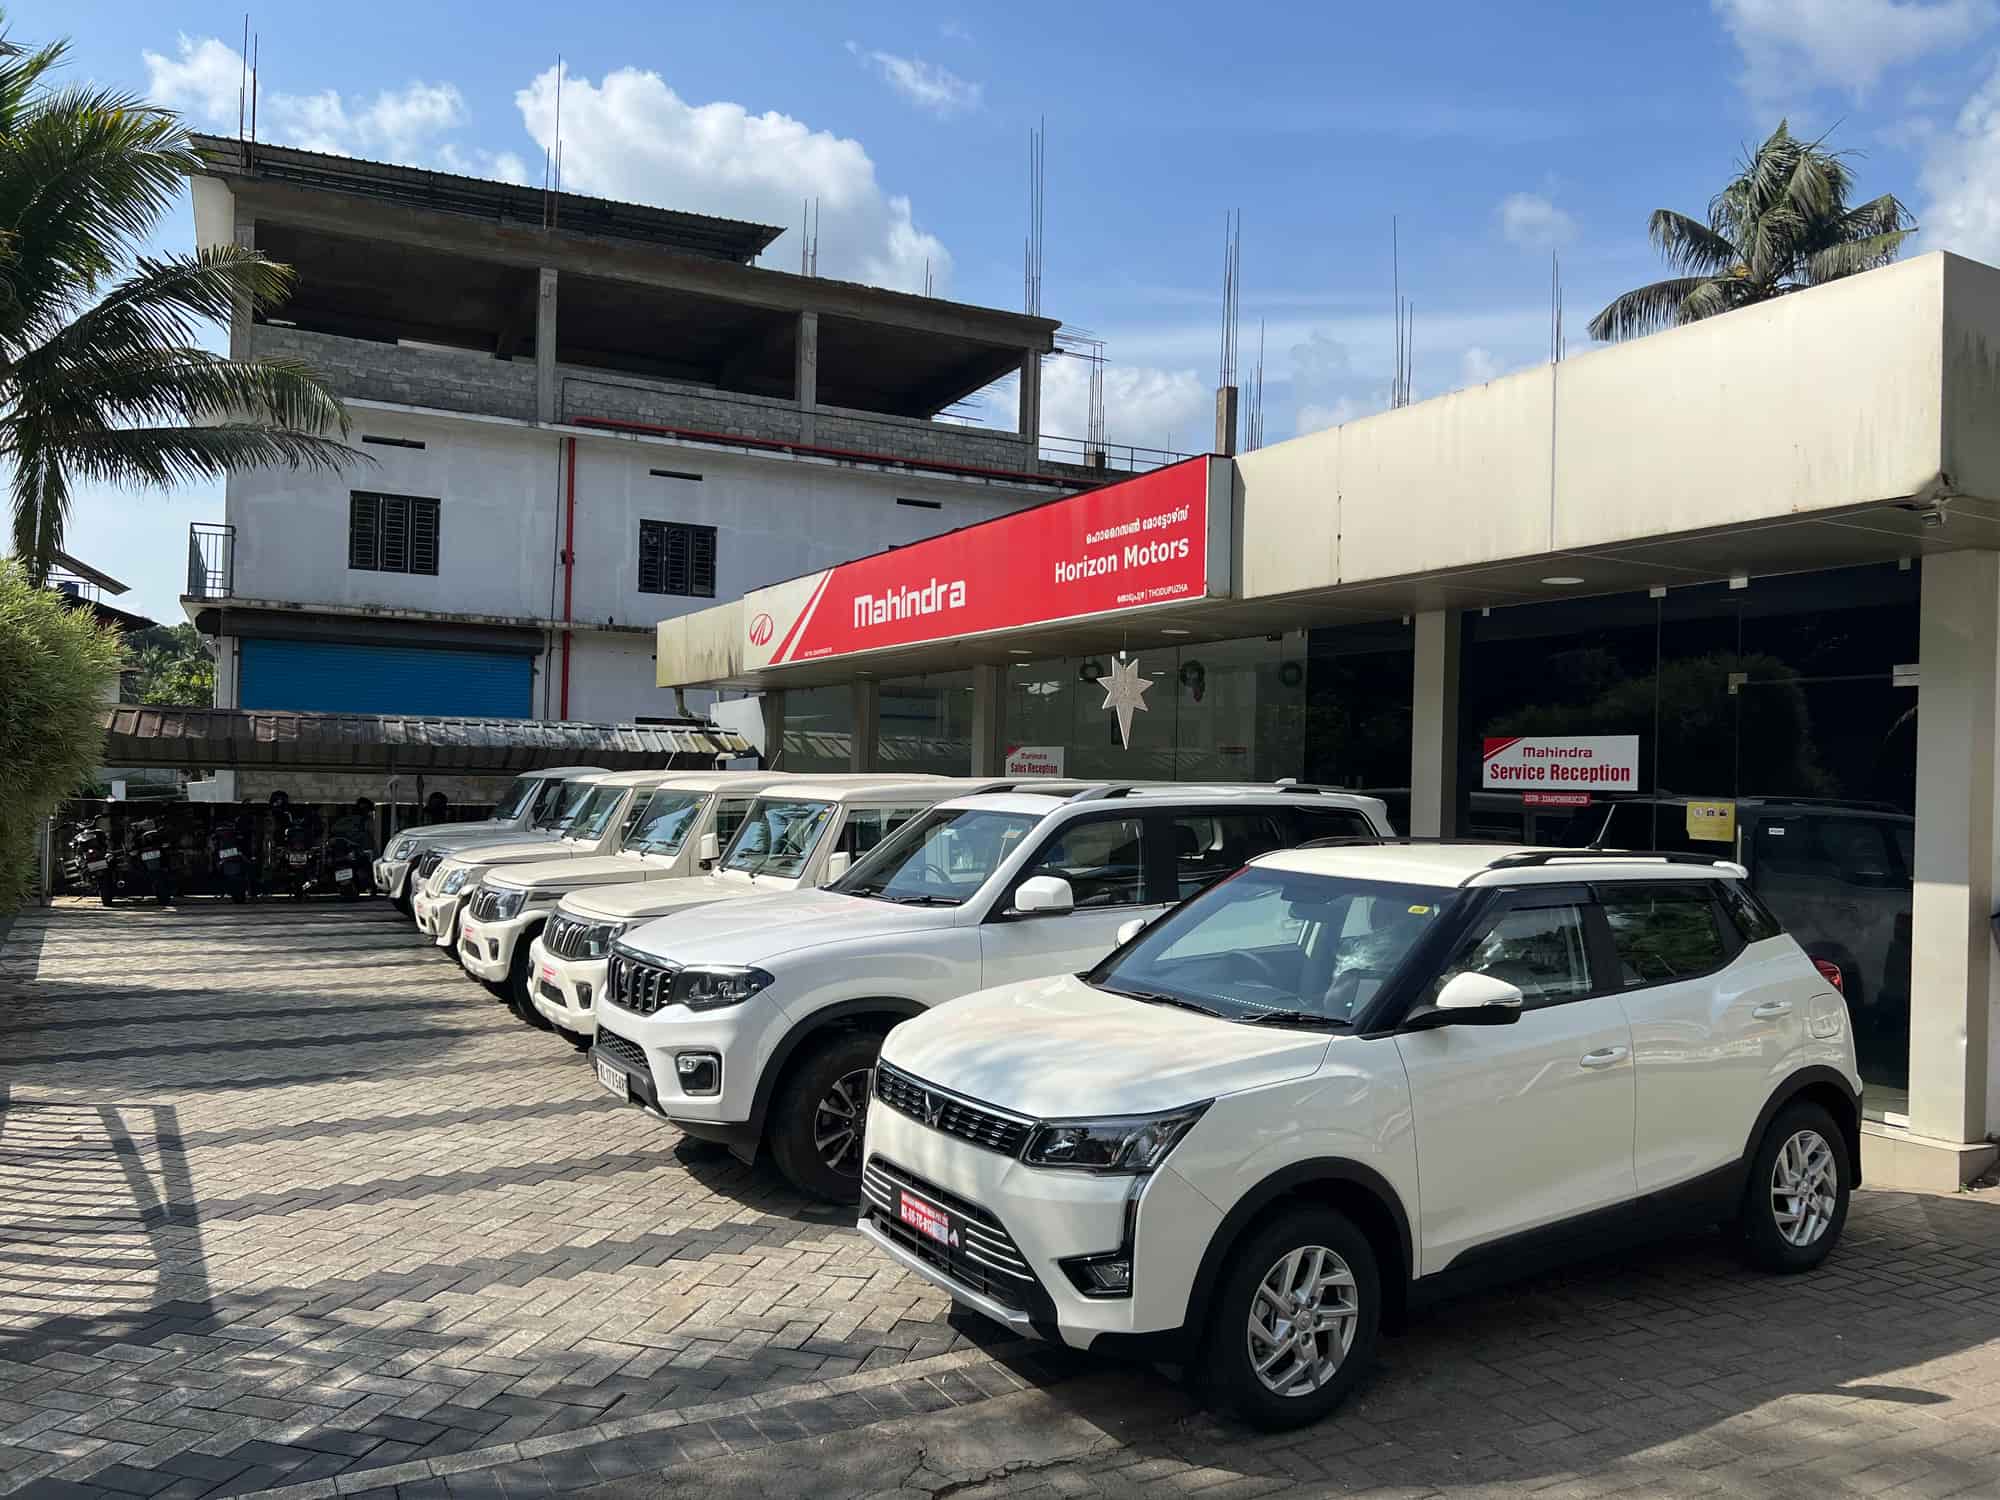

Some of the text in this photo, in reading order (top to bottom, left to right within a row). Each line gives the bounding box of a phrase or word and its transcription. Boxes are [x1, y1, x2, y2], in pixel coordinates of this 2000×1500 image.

[1055, 538, 1189, 584] Horizon Motors
[1148, 583, 1189, 599] THODUPUZHA
[854, 577, 966, 629] Mahindra
[1523, 746, 1593, 759] Mahindra
[1490, 763, 1631, 783] Service Reception
